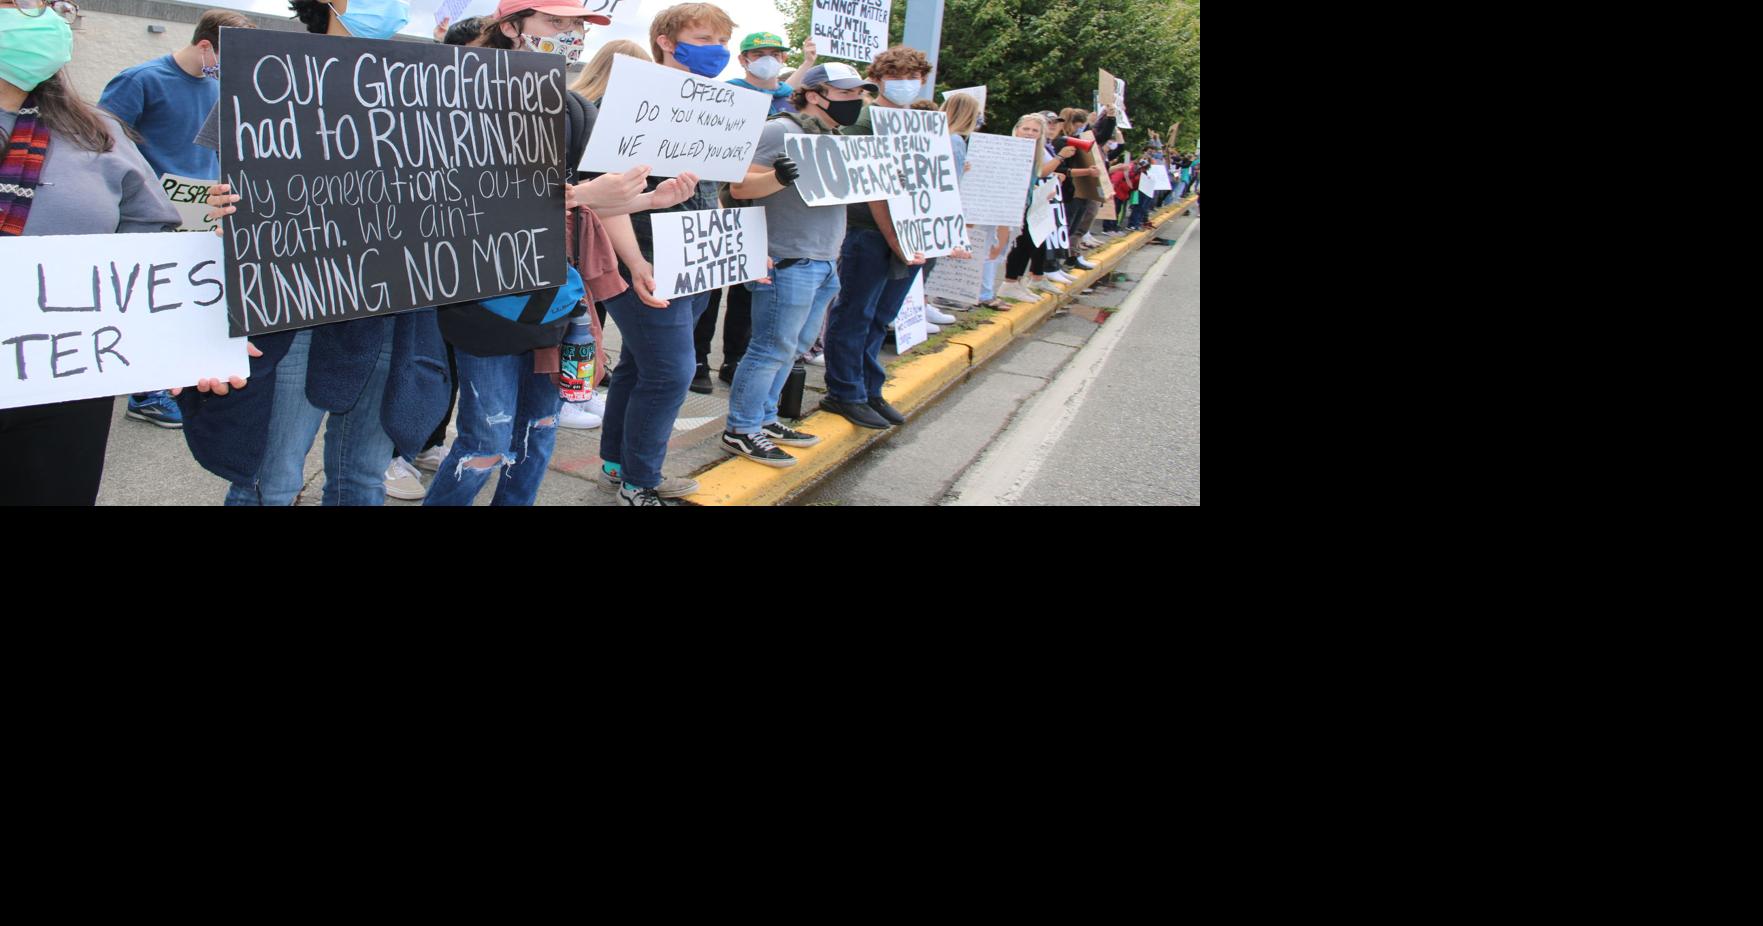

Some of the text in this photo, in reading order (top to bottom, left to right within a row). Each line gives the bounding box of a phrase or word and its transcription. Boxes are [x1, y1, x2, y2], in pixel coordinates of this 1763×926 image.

[834, 14, 870, 34] UNTIL
[860, 4, 888, 24] MATTER
[814, 23, 879, 49] BLACK LIVES
[830, 39, 871, 61] MATTER
[233, 95, 301, 161] had
[316, 107, 360, 161] to
[635, 100, 746, 131] DO YOU KNOW WHY
[872, 109, 902, 135] WHO
[903, 111, 921, 134] DO
[617, 134, 645, 157] WE
[657, 139, 704, 159] PULLED
[704, 143, 722, 161] YOU
[840, 136, 891, 162] JUSTICE
[893, 135, 930, 152] REALLY
[786, 135, 850, 201] NO
[849, 162, 901, 196] PEACE
[892, 153, 954, 192] ERVE
[227, 169, 276, 219] My
[909, 190, 931, 216] TO
[229, 205, 347, 260] breath.
[419, 194, 485, 238] ain't
[681, 208, 742, 244] BLACK
[896, 214, 964, 257] PROTECT?
[683, 231, 744, 267] LIVES
[37, 260, 224, 313] LIVES
[239, 227, 551, 332] RUNNING NO MORE
[673, 253, 749, 295] MATTER
[2, 326, 130, 381] TER
